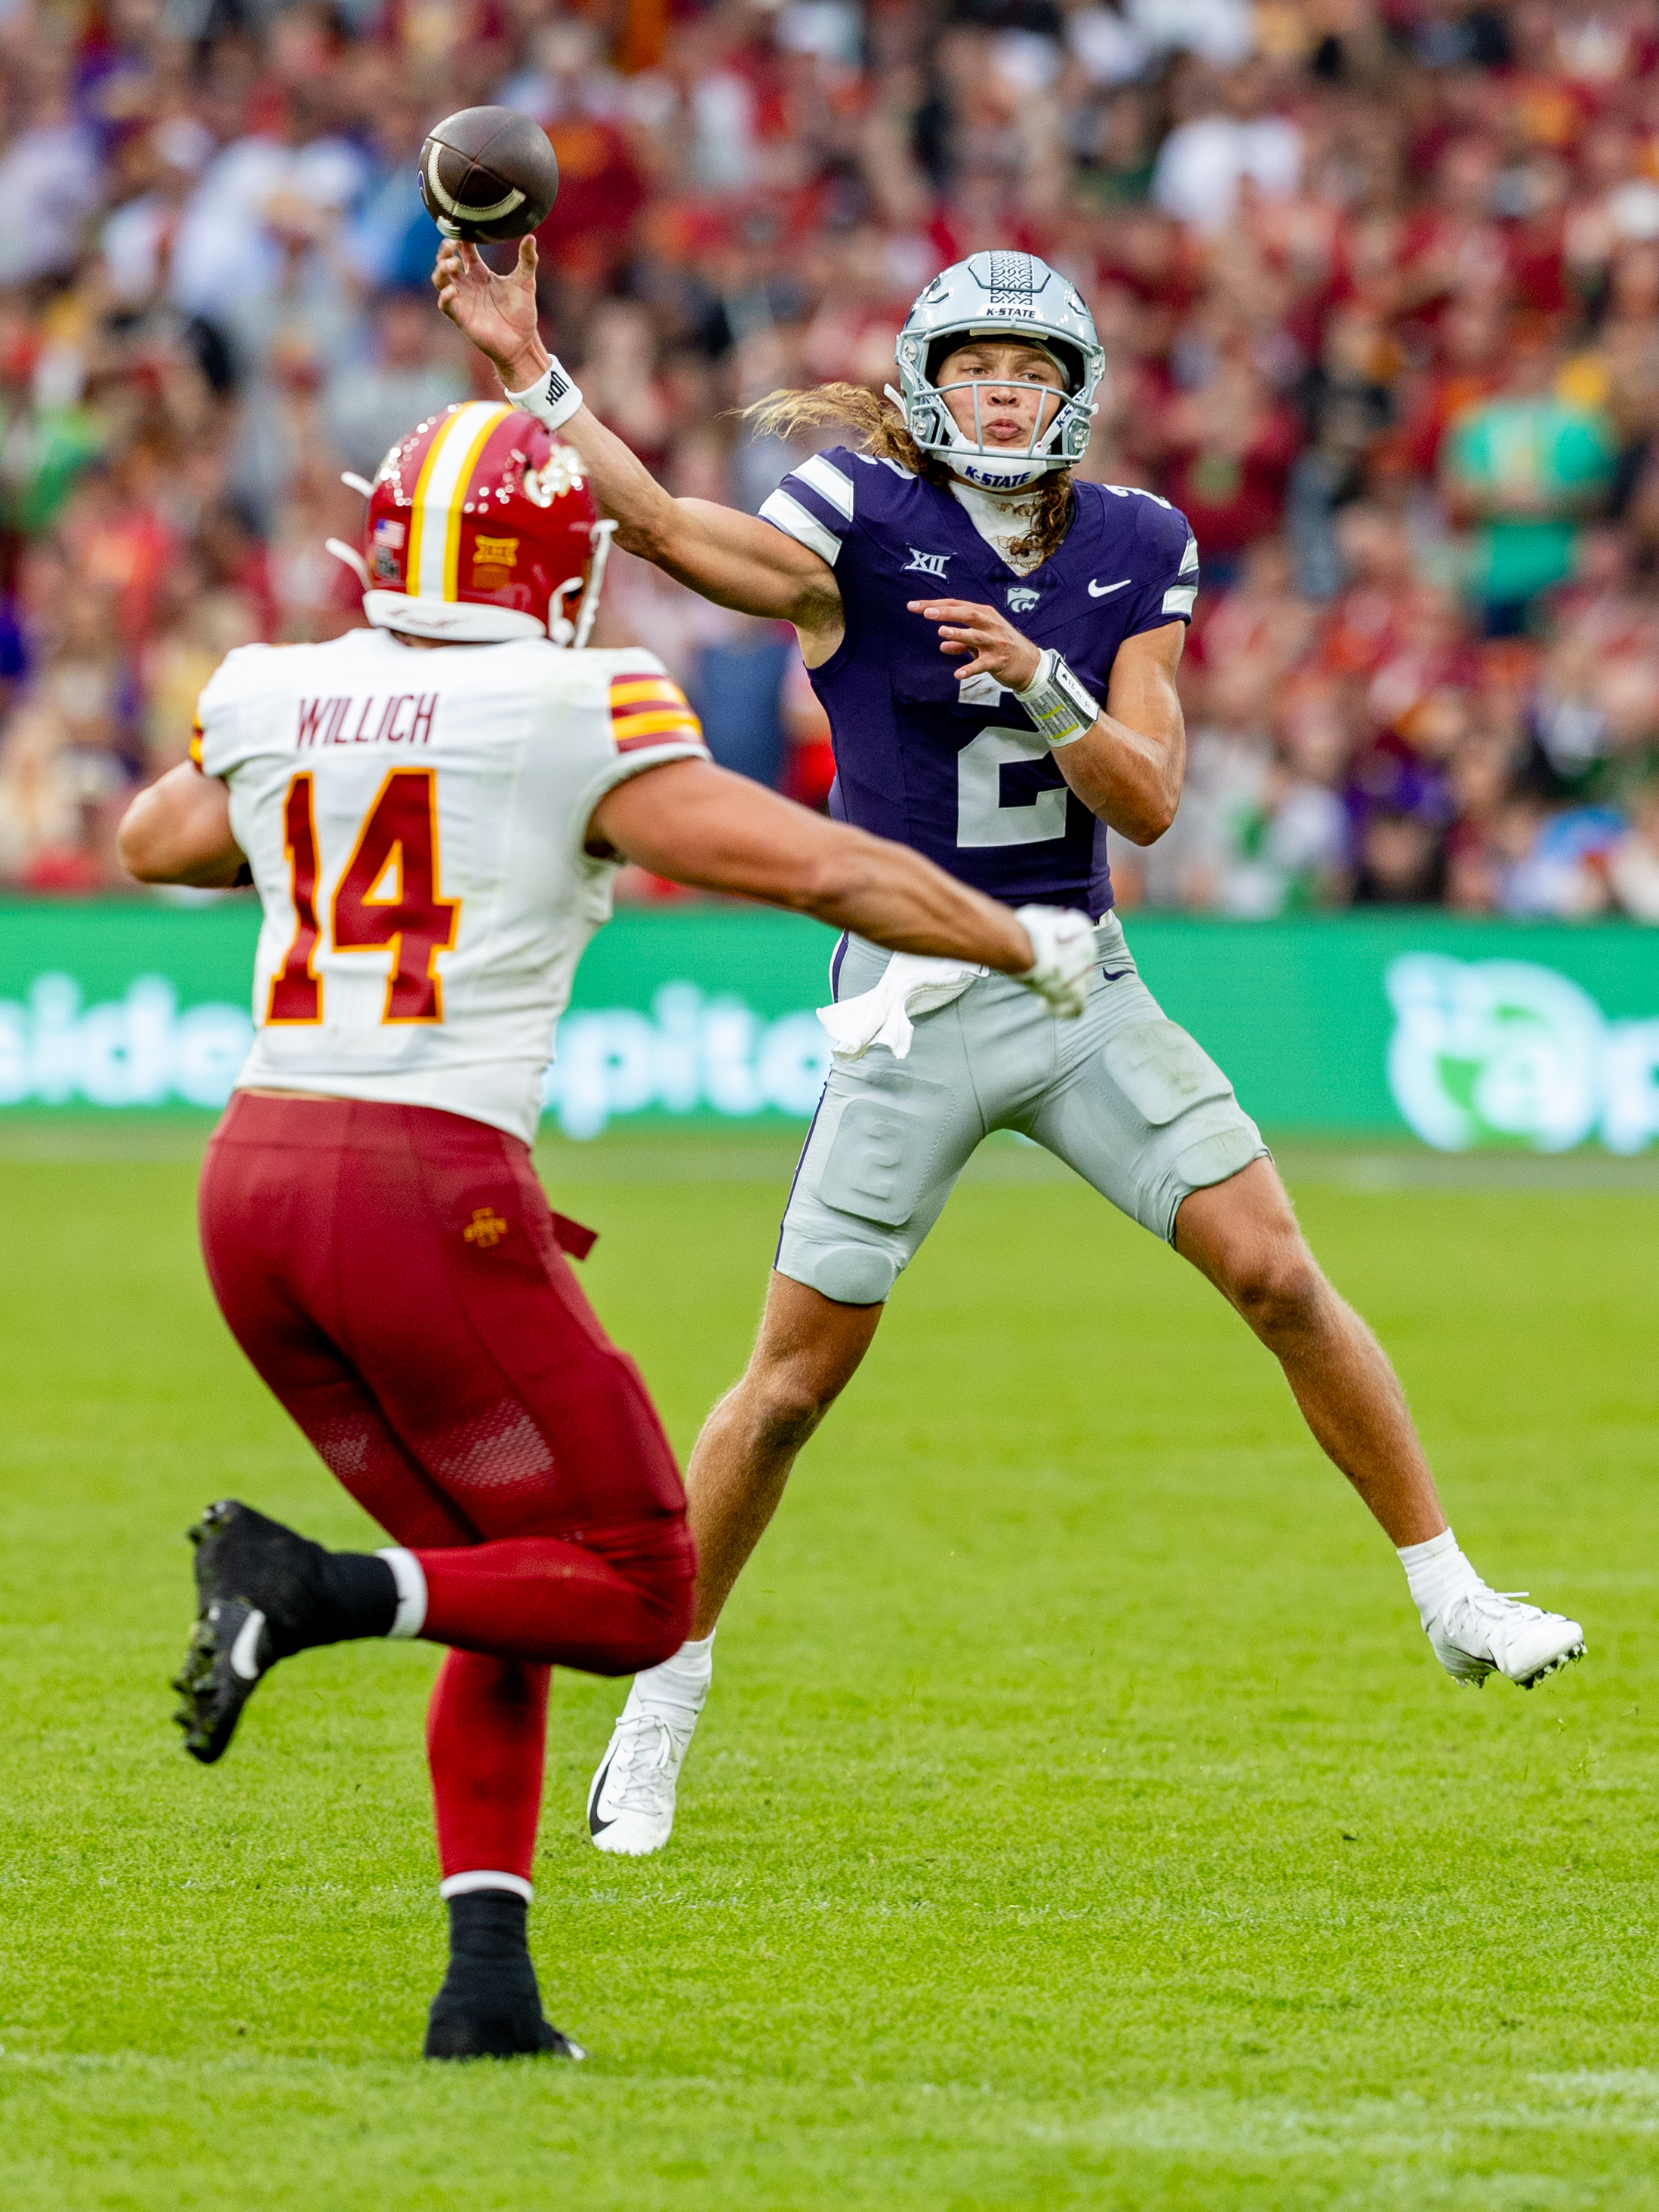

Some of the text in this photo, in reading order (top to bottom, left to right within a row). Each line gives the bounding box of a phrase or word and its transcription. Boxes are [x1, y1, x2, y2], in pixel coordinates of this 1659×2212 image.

[986, 307, 1036, 318] K-STATE
[965, 465, 1032, 488] K-STATE
[904, 546, 952, 580] XII
[297, 692, 439, 749] WILLICH
[957, 670, 1070, 848] 2
[263, 765, 463, 1026] 14
